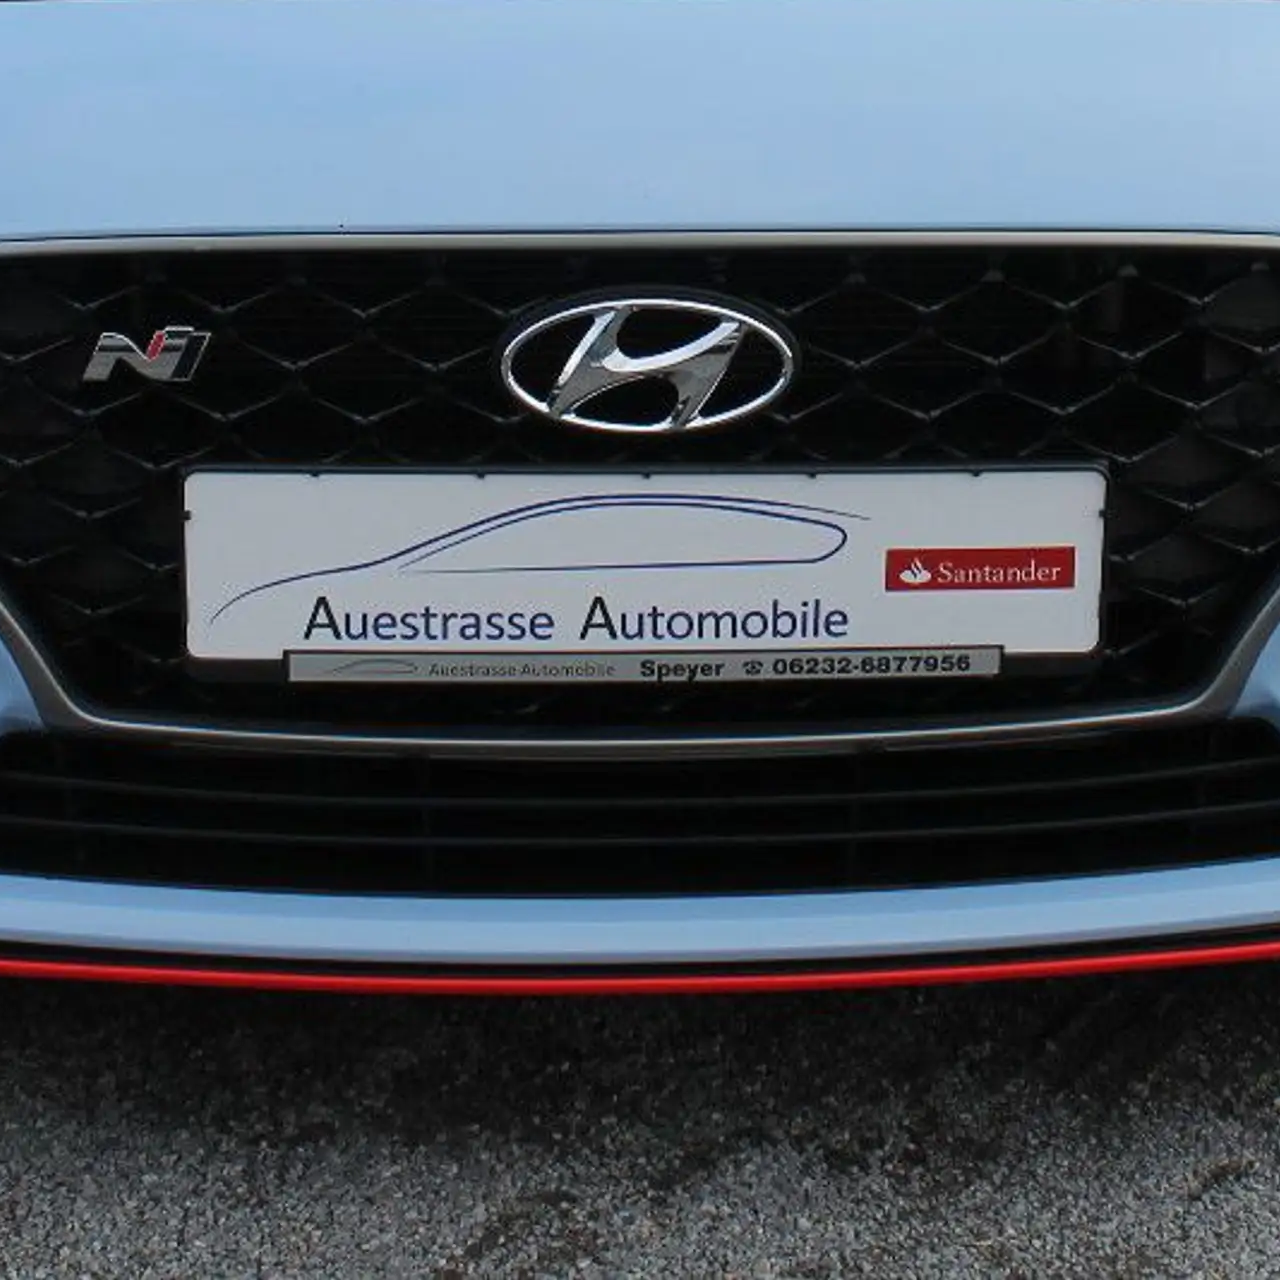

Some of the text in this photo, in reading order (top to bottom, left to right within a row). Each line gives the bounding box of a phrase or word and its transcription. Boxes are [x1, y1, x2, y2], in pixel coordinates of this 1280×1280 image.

[936, 559, 1062, 584] Santander
[303, 595, 850, 641] Auestrasse Automobile
[428, 654, 972, 683] Auestrasse Automobile Speyer 06232-6877956
